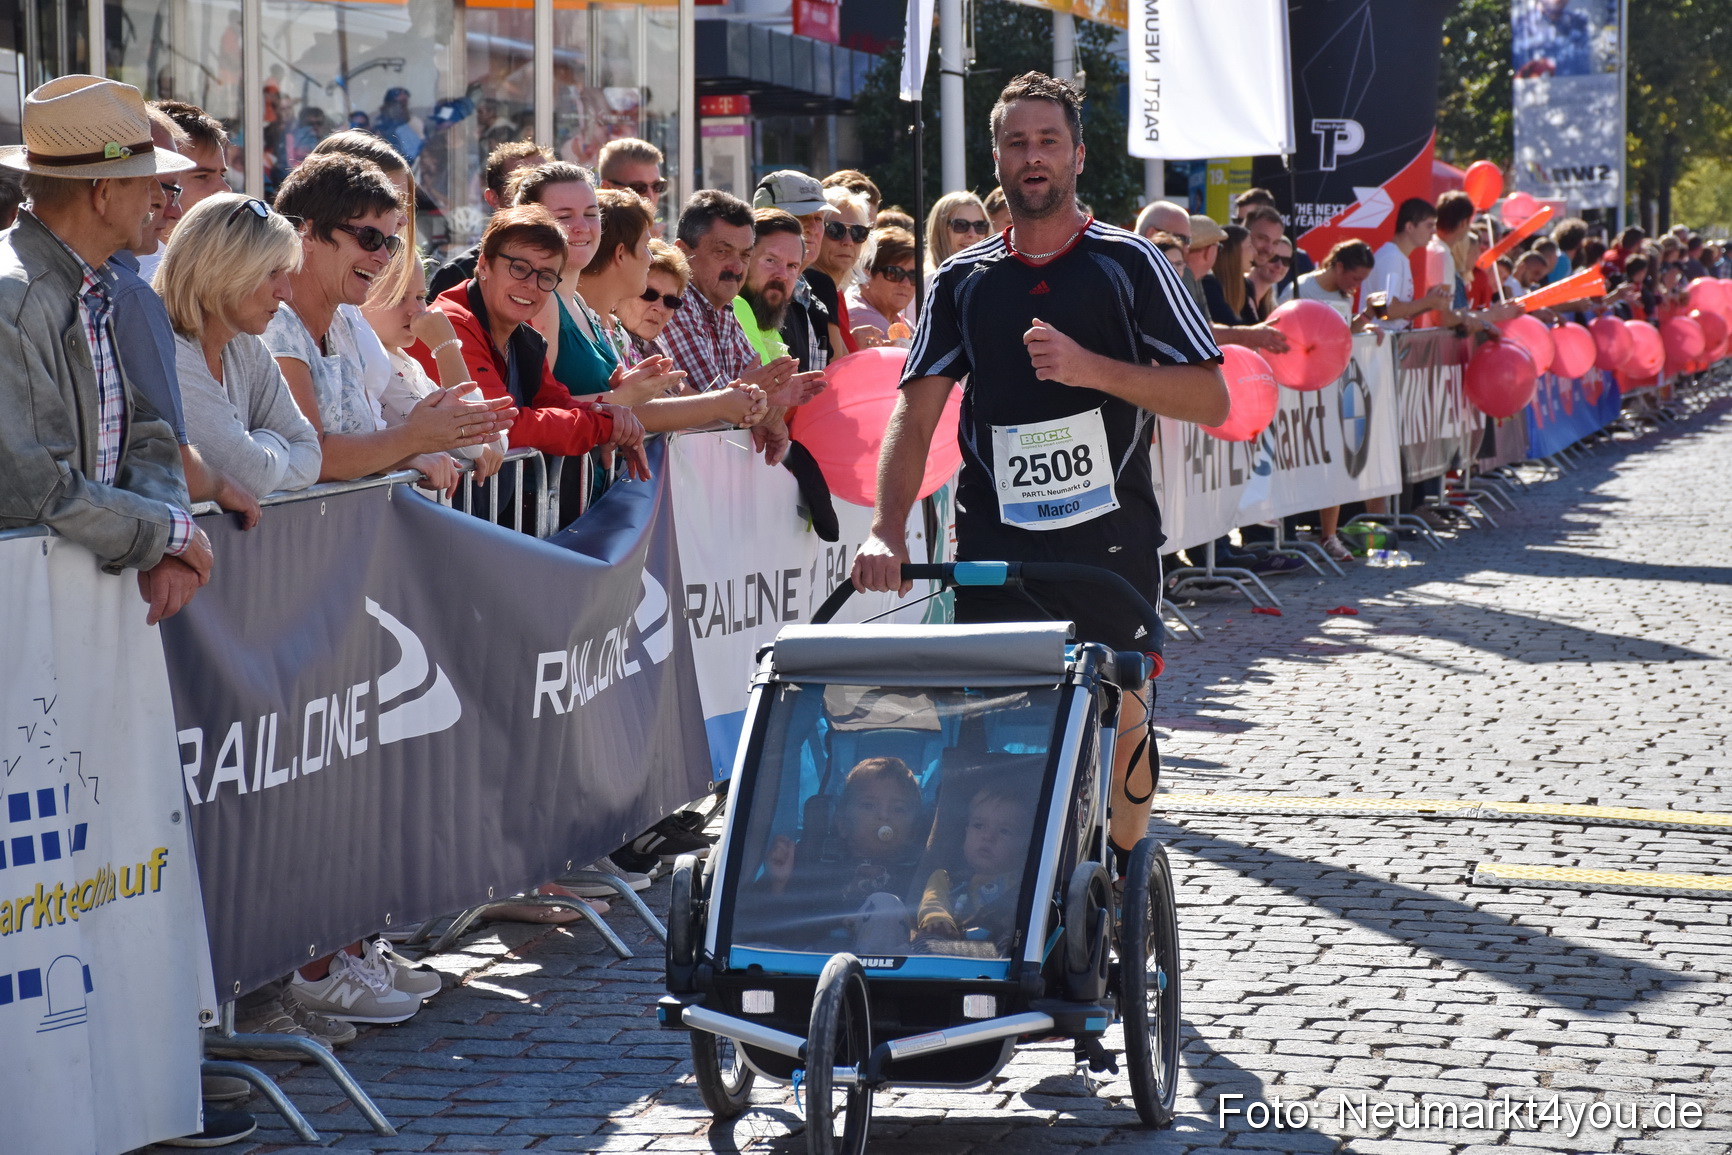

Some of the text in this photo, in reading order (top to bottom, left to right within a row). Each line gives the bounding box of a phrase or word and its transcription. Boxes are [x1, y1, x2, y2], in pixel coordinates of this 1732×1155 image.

[1316, 203, 1347, 216] NEXT
[1020, 427, 1072, 446] BOCK
[1008, 444, 1093, 488] 2508
[1022, 484, 1081, 499] PARTL Neumarkt
[1037, 500, 1080, 518] Marco
[857, 958, 894, 968] HULE
